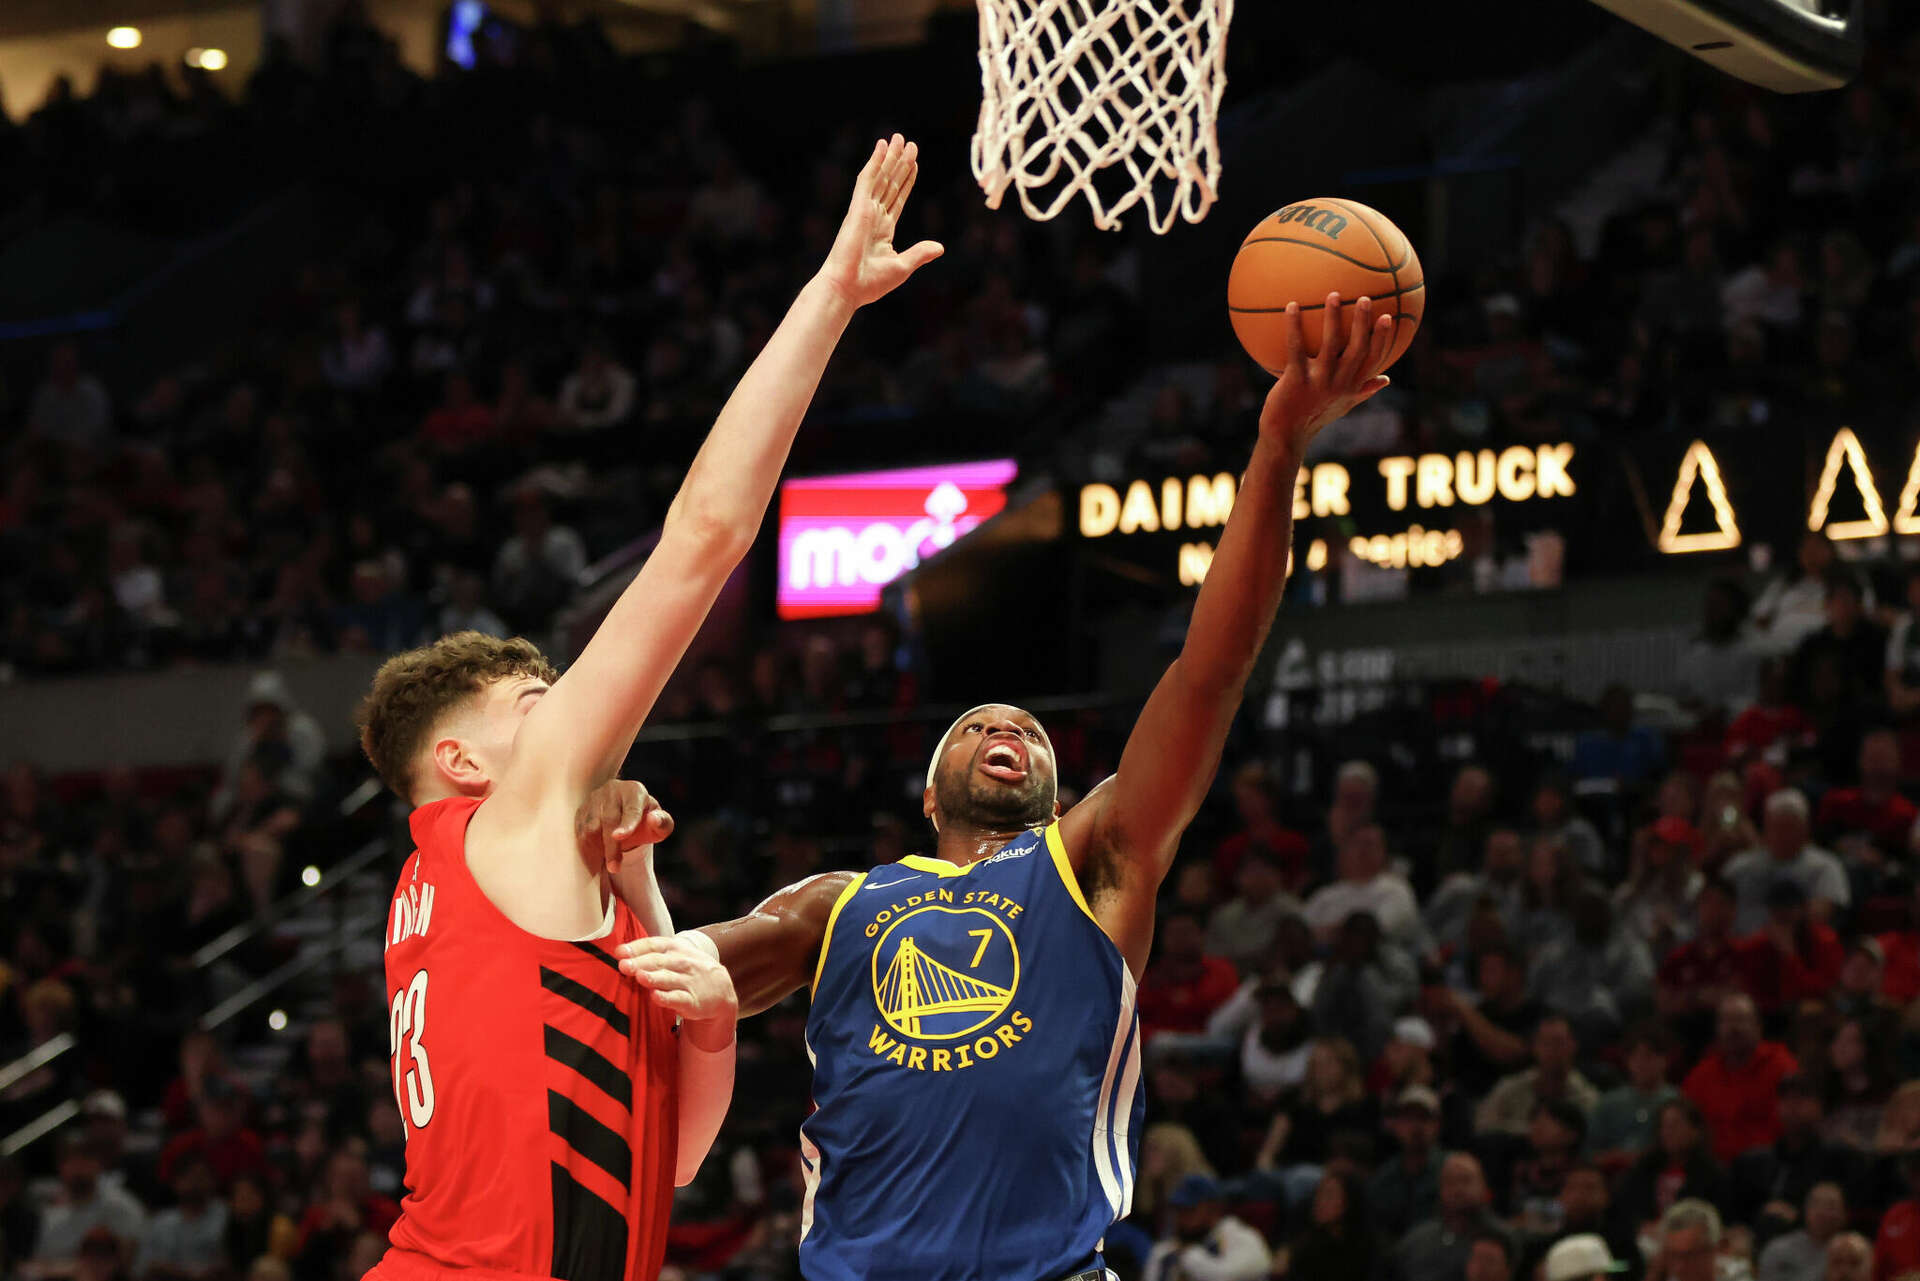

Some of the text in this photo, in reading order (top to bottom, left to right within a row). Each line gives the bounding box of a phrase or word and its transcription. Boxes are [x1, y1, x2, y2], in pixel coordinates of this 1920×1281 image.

[1080, 442, 1577, 538] DAIMER TRUCK
[864, 887, 1024, 938] GOLDEN STATE
[967, 928, 993, 968] 7
[868, 1010, 1033, 1072] WARRIORS
